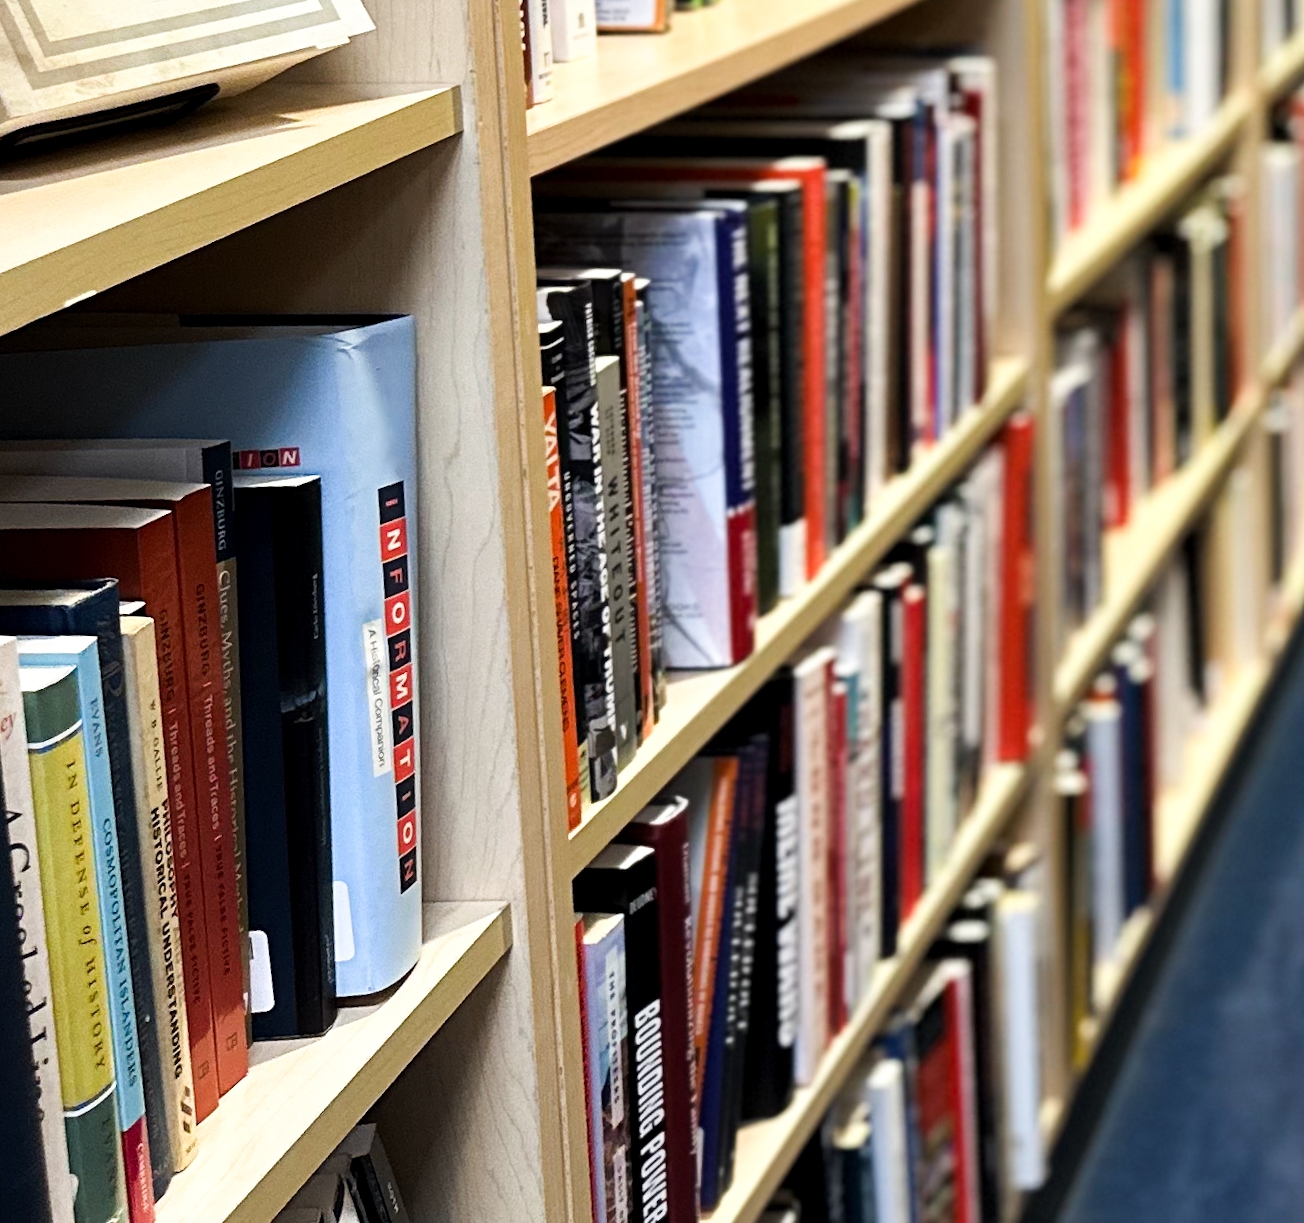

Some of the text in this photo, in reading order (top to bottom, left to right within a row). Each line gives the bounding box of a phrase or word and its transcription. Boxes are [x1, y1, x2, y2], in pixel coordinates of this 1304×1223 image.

[214, 469, 228, 551] GINZBURG
[543, 411, 562, 515] YALTA
[217, 570, 232, 629] Clues,
[562, 471, 582, 641] UNGOVERNED SPACES
[590, 401, 618, 732] WAR IN THE AGE OF TRUMP
[605, 474, 627, 646] WHITEOUT
[195, 583, 212, 677] GINZBURG
[159, 609, 188, 859] GINZBURG Threads and Traces
[204, 693, 217, 754] Threads
[224, 697, 237, 730] and
[374, 697, 389, 768] Companion
[383, 493, 416, 886] INFORMATION
[559, 661, 571, 733] CLEMENS
[153, 736, 165, 793] GALLIE
[209, 781, 221, 831] Traces
[66, 761, 105, 1071] IN DEFENSE of HISTORY
[89, 697, 138, 1089] EVANS COSMOPOLITAN ISLANDERS
[150, 806, 184, 1080] HISTORICAL UNDERSTANDING
[607, 971, 623, 1103] THE PROFITEERS
[633, 999, 668, 1223] BOUNDING POWER
